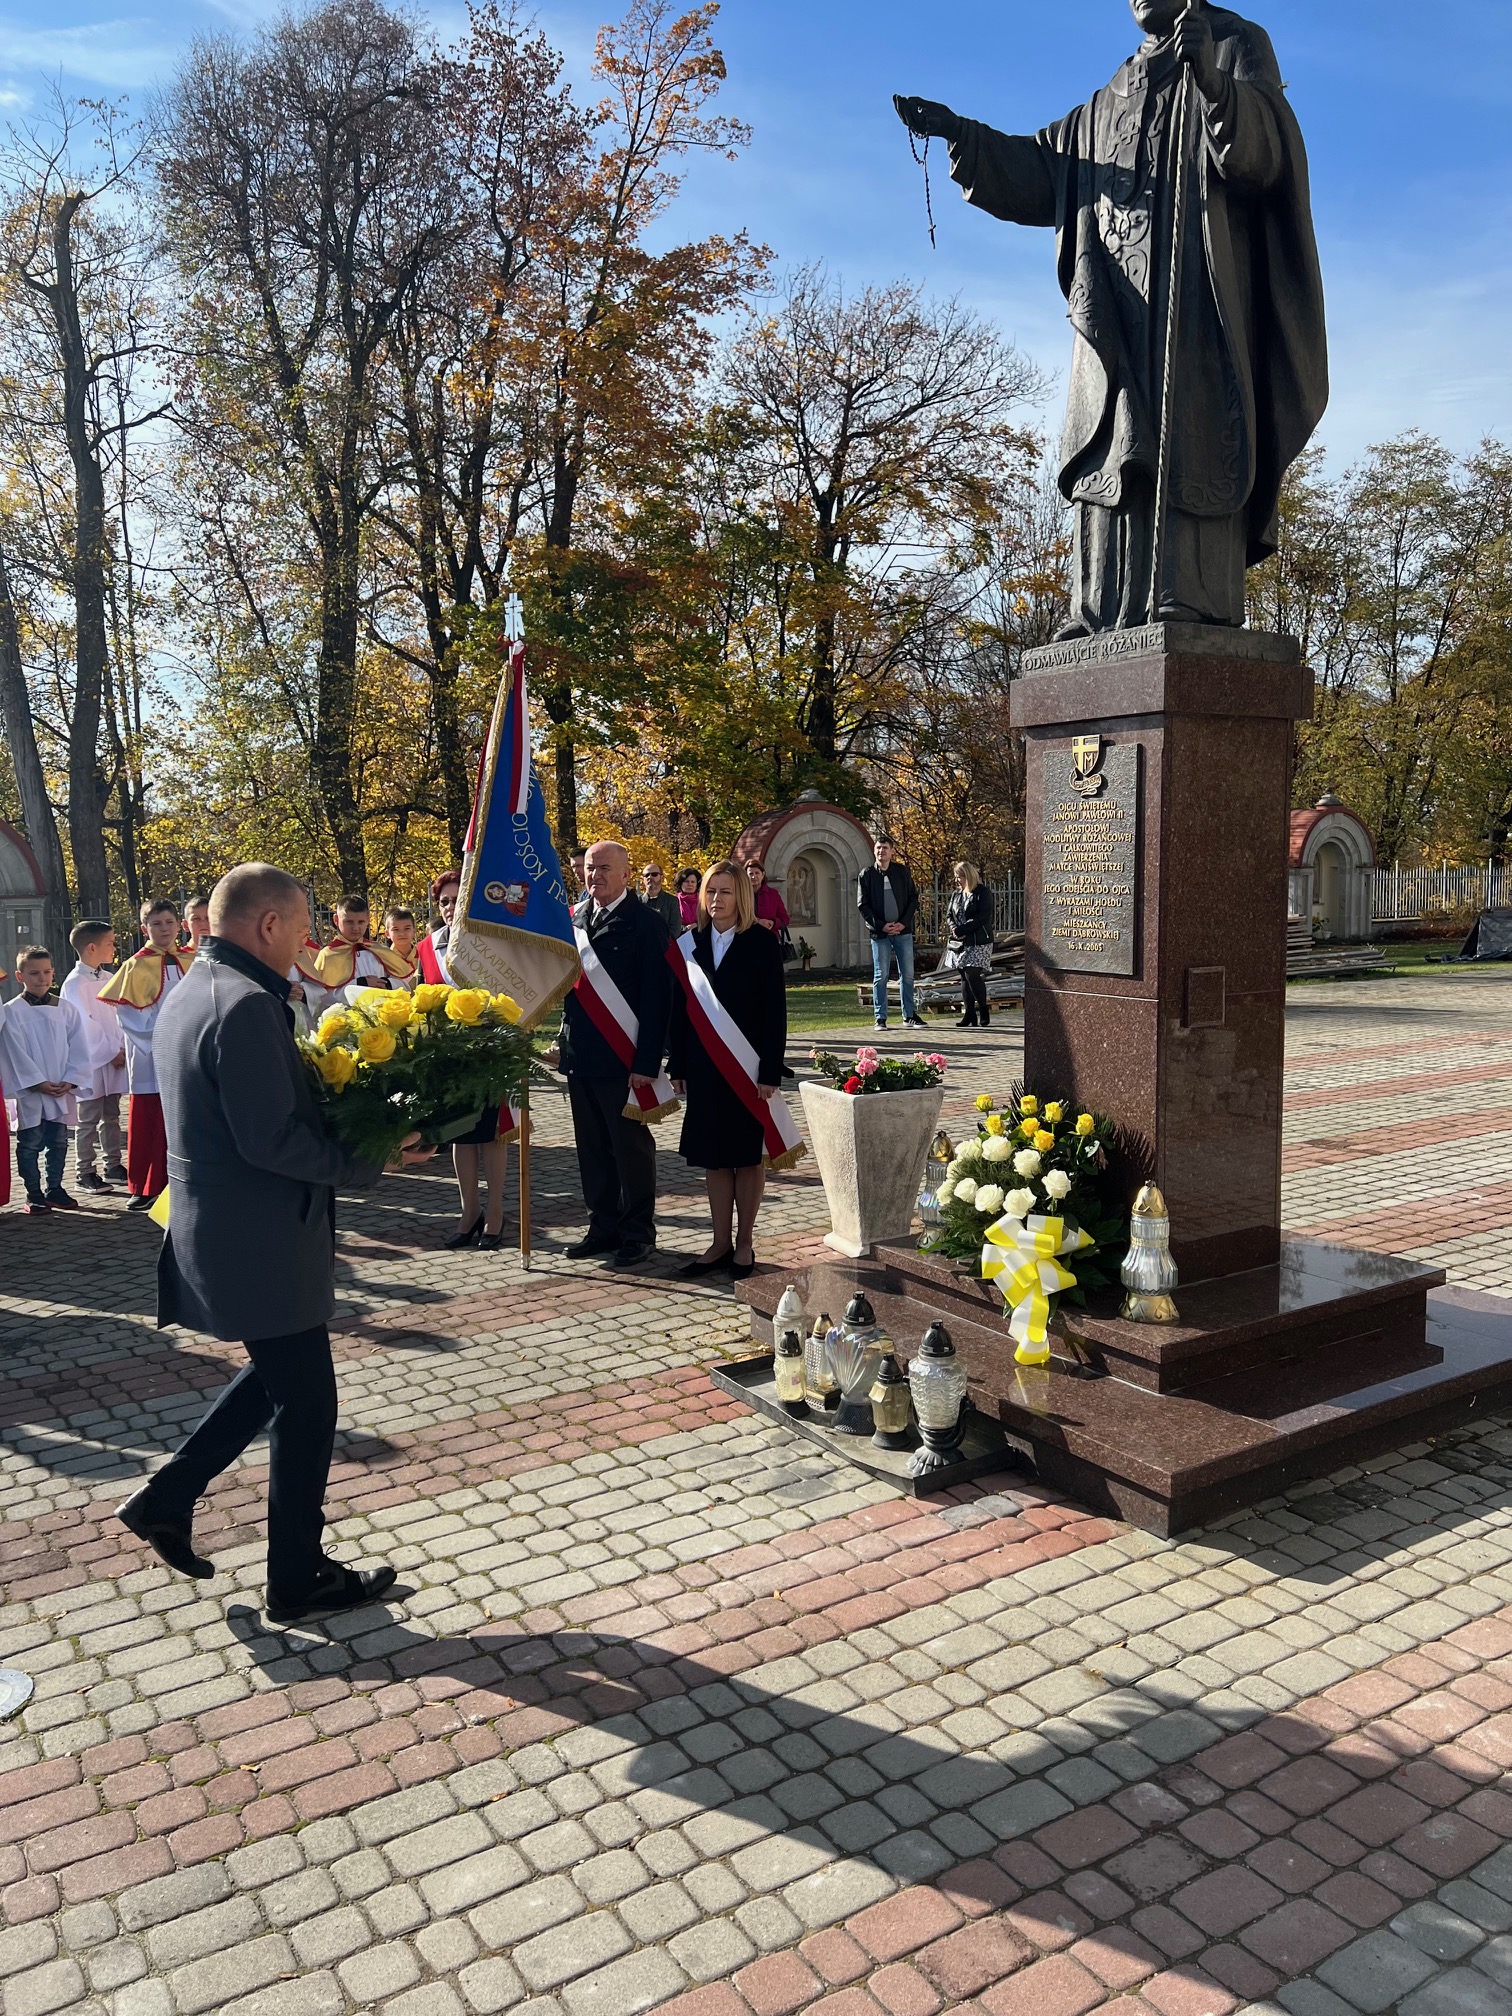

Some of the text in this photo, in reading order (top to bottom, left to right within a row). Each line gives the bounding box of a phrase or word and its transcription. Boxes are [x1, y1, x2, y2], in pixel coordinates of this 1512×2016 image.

[1100, 631, 1163, 656] RÓŻANIEC
[1058, 800, 1117, 812] OJCU ŚWIĘTEMU
[1052, 809, 1124, 822] JANOWI PAWŁOWI II
[1063, 823, 1110, 834] APOSTOŁOWI
[1043, 834, 1081, 844] MODLITWY
[1065, 843, 1114, 852] CAŁKOWITEGO
[1064, 852, 1109, 862] ZAWIERZENIA
[1049, 862, 1072, 872] MATCE
[1070, 875, 1101, 884] W ROKU
[1044, 884, 1130, 895] JEGO ODEJŚCIA DO OJCA
[1056, 896, 1093, 906] WYRAZAMI
[1095, 897, 1122, 907] HOŁDU
[1052, 928, 1070, 937] ZIEMI
[470, 935, 538, 1004] SZKAPLERZNEJ
